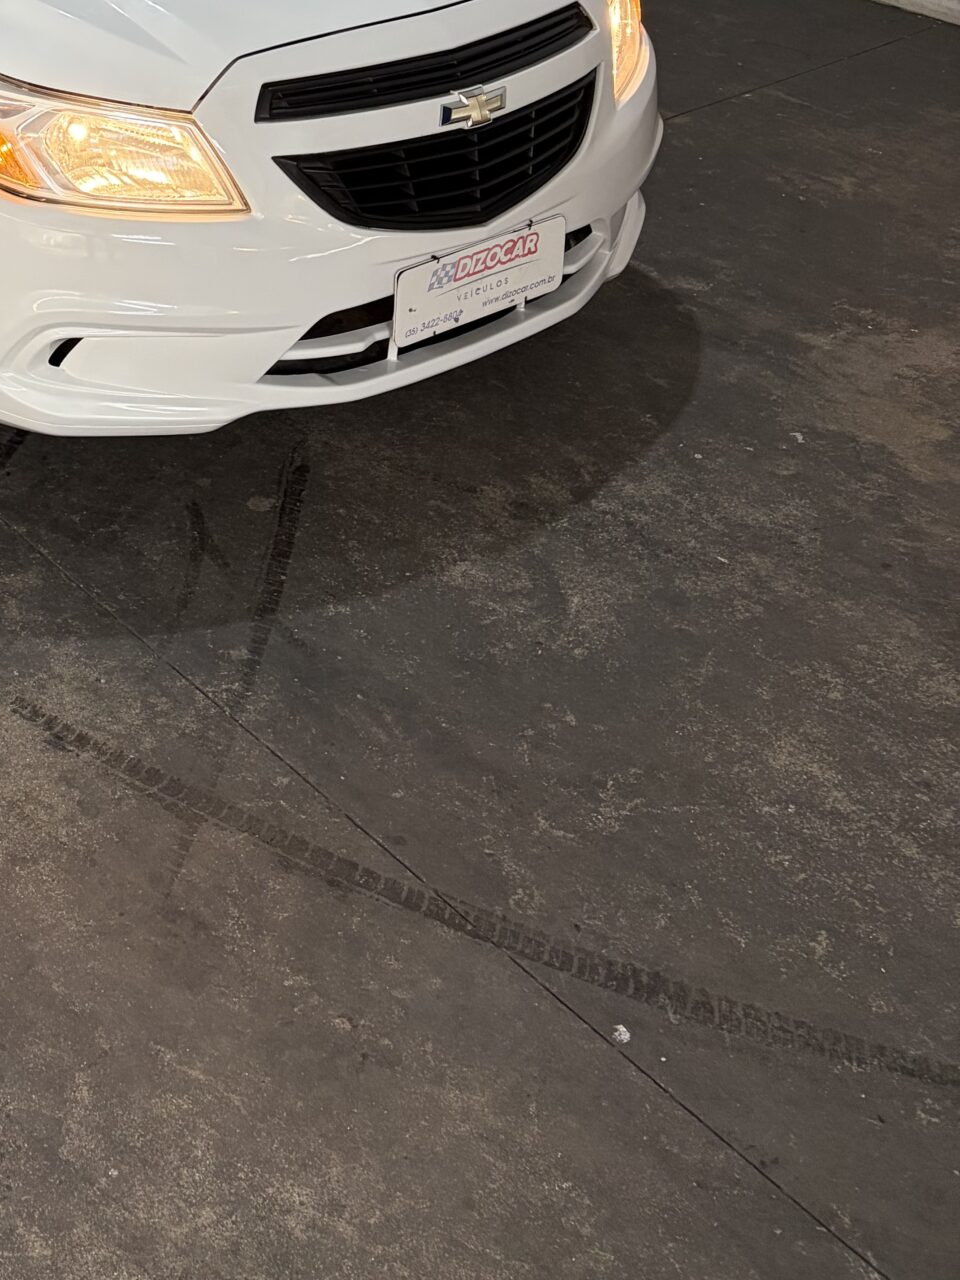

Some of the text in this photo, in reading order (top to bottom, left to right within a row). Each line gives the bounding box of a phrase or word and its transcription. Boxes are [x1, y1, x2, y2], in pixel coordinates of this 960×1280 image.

[453, 231, 540, 282] DIZOCAR
[457, 277, 510, 301] VEÍCULOS
[482, 274, 556, 308] www.dizocar.com.br
[404, 327, 419, 338] (35)
